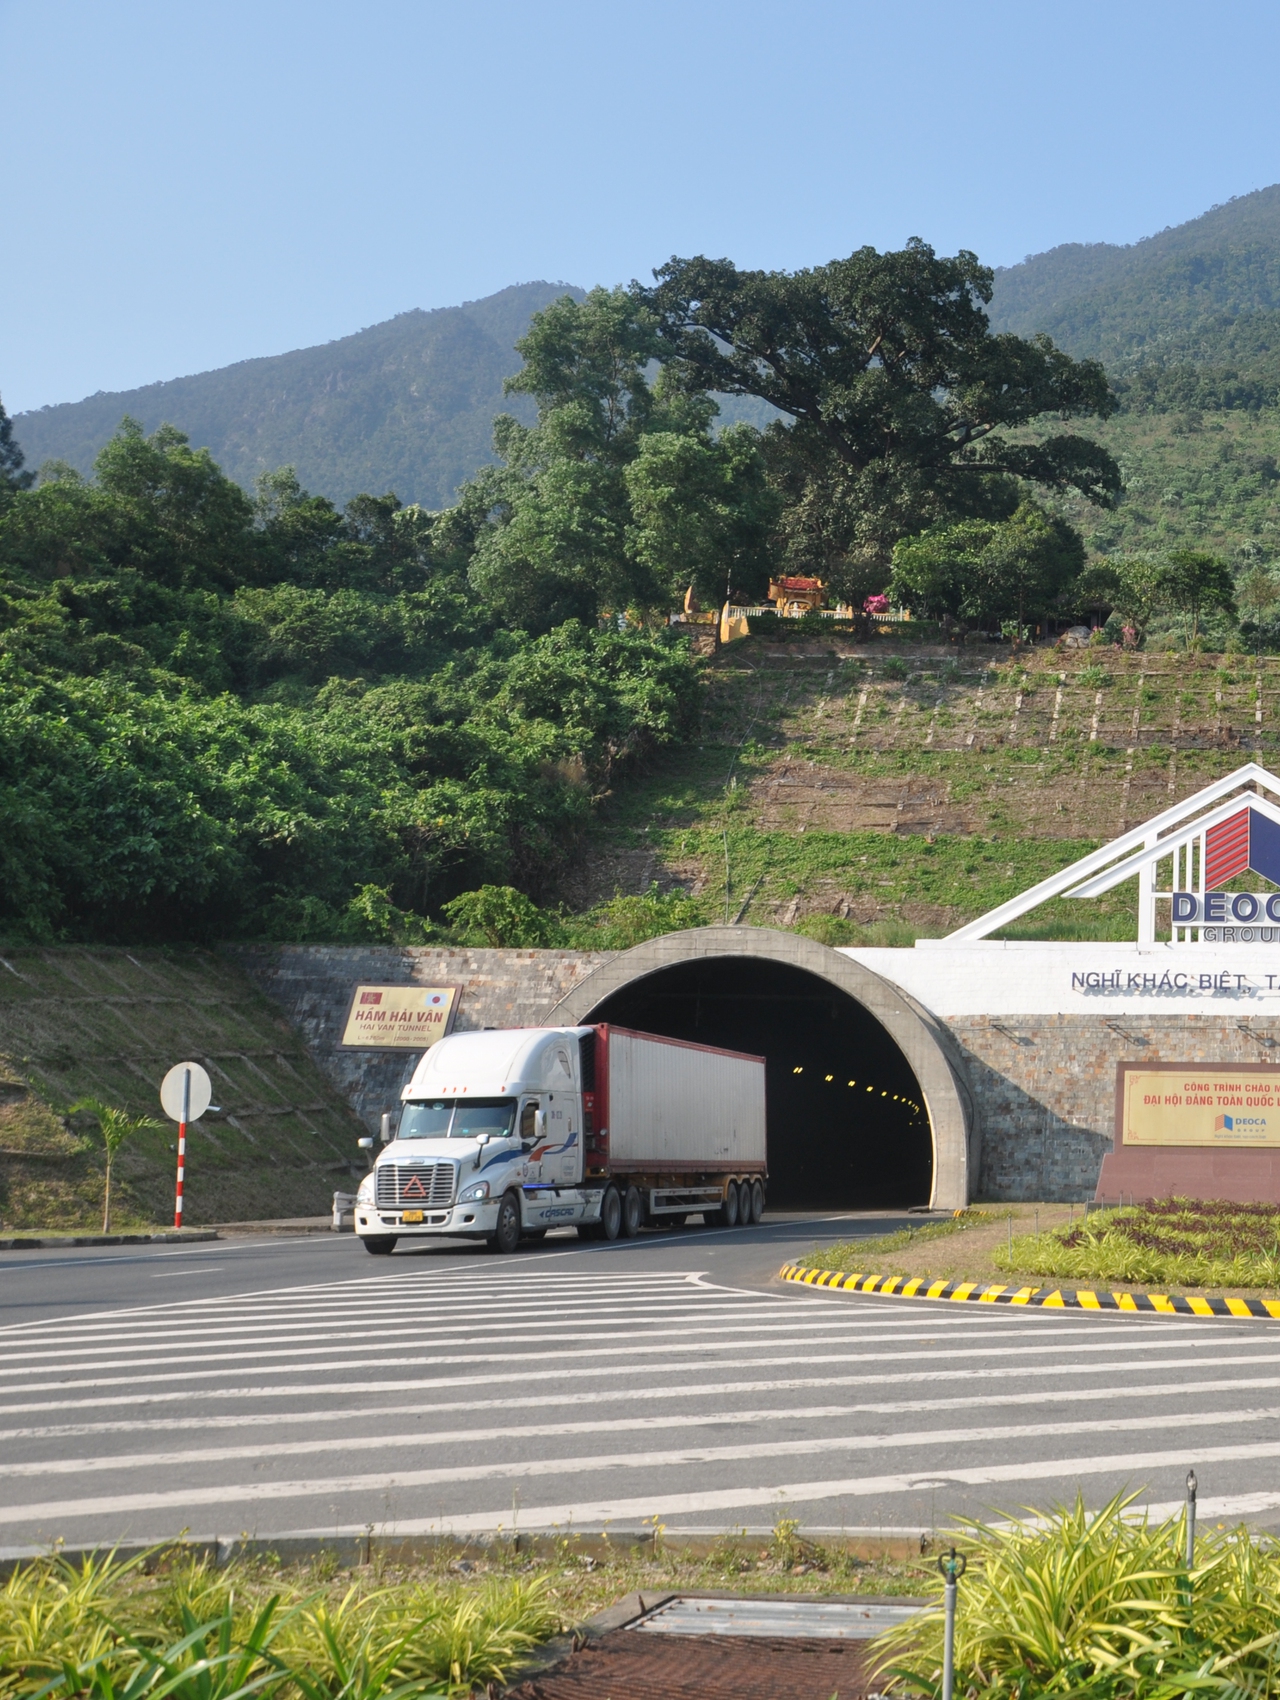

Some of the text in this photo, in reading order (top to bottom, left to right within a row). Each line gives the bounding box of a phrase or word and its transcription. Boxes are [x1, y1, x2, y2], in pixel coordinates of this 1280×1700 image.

[1072, 969, 1122, 988] NGHĨ
[1127, 969, 1188, 989] KHÁC
[389, 1008, 413, 1023] HẢI
[417, 1009, 443, 1023] VÂN
[1184, 1082, 1210, 1091] CÔNG
[1213, 1082, 1242, 1092] TRÌNH
[1245, 1083, 1271, 1093] CHÀO
[1144, 1095, 1161, 1107] ĐẠI
[1164, 1093, 1182, 1107] HỘI
[1185, 1093, 1213, 1106] ĐẢNG
[1217, 1094, 1243, 1106] TOÀN
[1246, 1094, 1274, 1107] QUỐC
